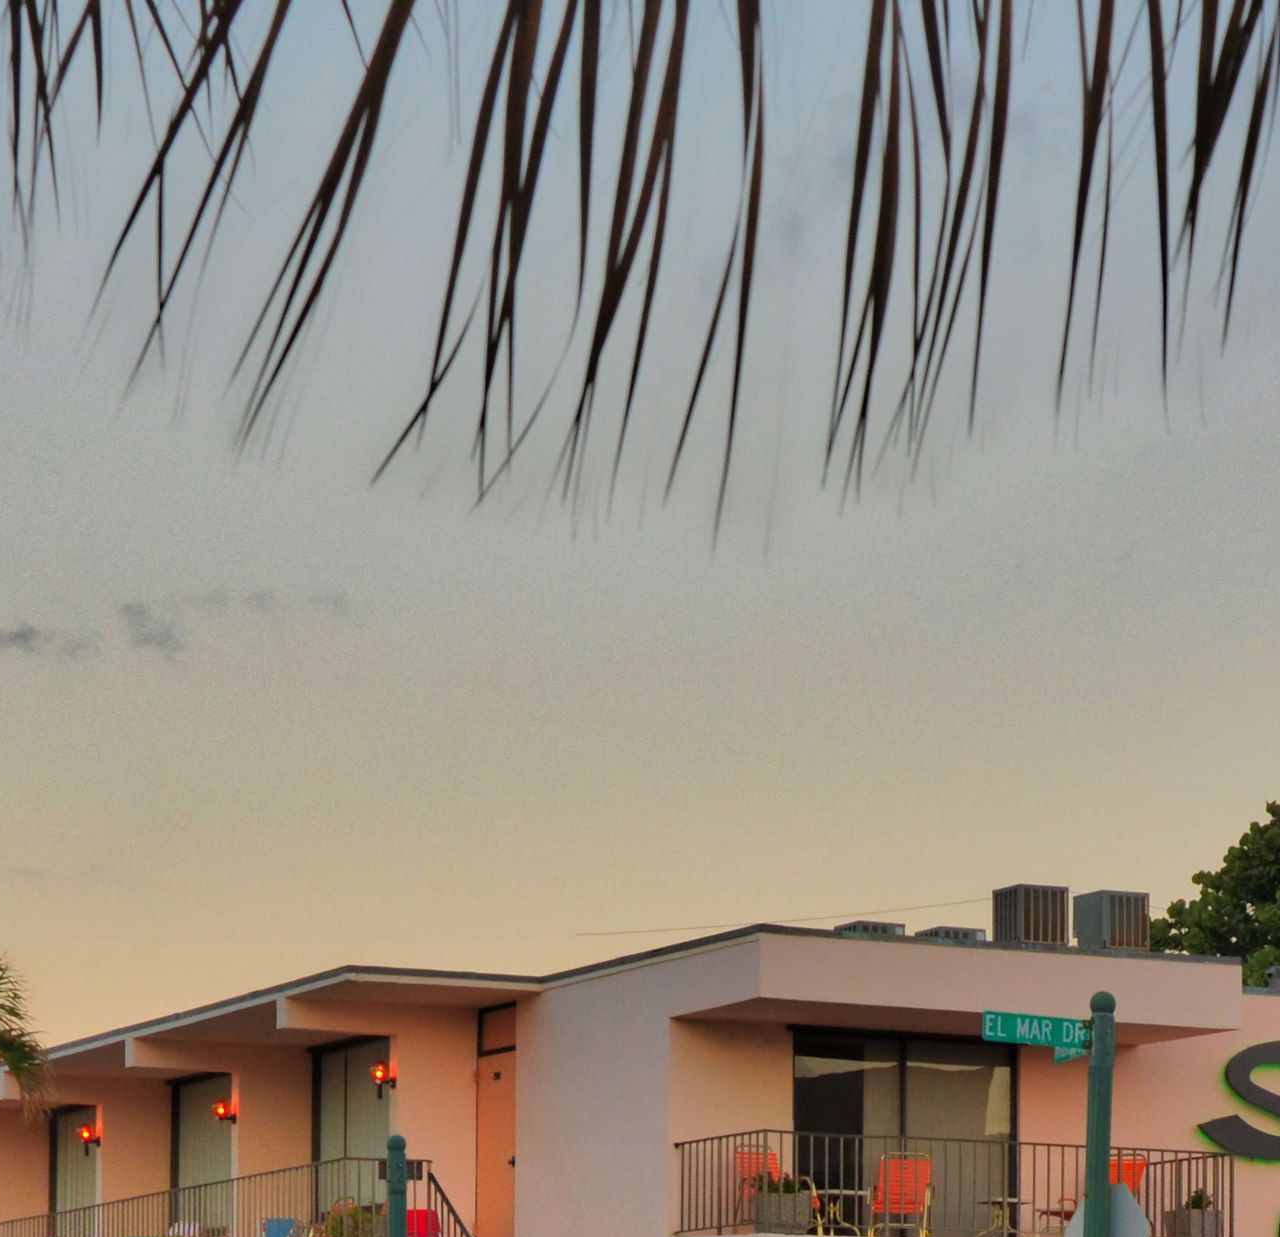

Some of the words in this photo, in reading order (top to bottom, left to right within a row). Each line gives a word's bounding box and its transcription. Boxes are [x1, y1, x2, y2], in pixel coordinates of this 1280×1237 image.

[985, 1014, 1007, 1037] EL
[1016, 1017, 1053, 1041] MAR
[1063, 1022, 1086, 1044] DR
